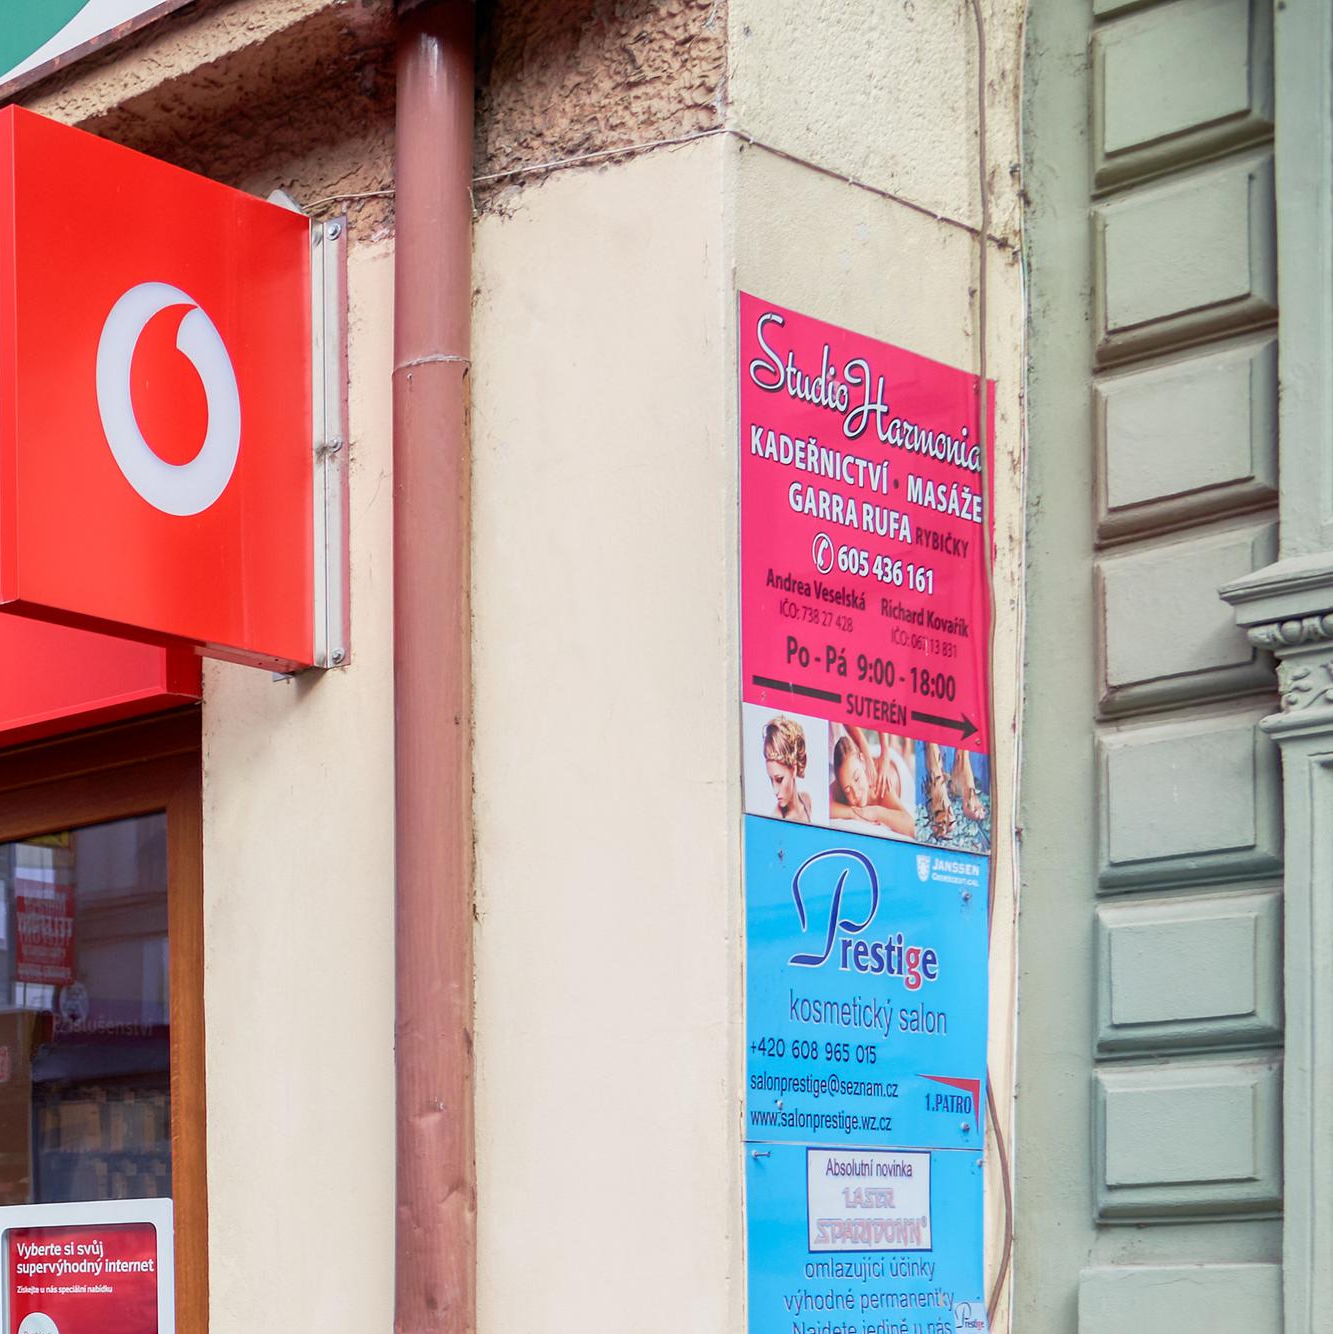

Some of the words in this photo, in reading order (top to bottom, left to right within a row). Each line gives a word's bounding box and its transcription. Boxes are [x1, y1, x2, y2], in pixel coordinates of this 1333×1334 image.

[749, 313, 850, 413] Studio
[842, 358, 982, 473] Harmonia
[750, 424, 890, 495] KADEŘNICTVÍ
[906, 474, 983, 524] MASÁŽE
[788, 481, 859, 529] GARRA
[861, 503, 913, 544] RUFA
[914, 526, 969, 560] RYBIČKY
[837, 544, 870, 578] 605
[872, 554, 904, 587] 436
[907, 564, 934, 595] 161
[766, 568, 812, 597] Andrea
[813, 577, 866, 612] Veselská
[779, 599, 801, 621] IČO:
[801, 605, 821, 626] 738
[821, 610, 835, 628] 27
[835, 613, 854, 633] 428
[881, 598, 925, 627] Richard
[926, 611, 969, 639] Kovařík
[786, 635, 810, 668] Po
[826, 645, 848, 677] Pá
[856, 654, 896, 688] 9:00
[910, 666, 957, 702] 18:00
[845, 692, 908, 726] SUTERÉN
[932, 858, 980, 877] JANSSEN
[787, 848, 939, 991] Prestige
[789, 988, 894, 1039] kosmetický
[899, 1001, 948, 1035] salon
[750, 1037, 786, 1058] +420
[791, 1039, 819, 1060] 608
[825, 1041, 851, 1063] 965
[855, 1044, 878, 1065] 015
[750, 1071, 899, 1099] salonprestige@seznam.cz
[924, 1092, 973, 1115] 1.PATRO
[750, 1108, 892, 1135] www.salonprestige.wz.cz
[825, 1158, 874, 1179] Absolutní
[876, 1159, 913, 1178] novinka
[842, 1186, 896, 1210] LASER
[16, 1242, 61, 1260] Vyberte
[63, 1242, 75, 1256] si
[78, 1239, 104, 1259] svůj
[16, 1258, 103, 1277] supervýhodný
[105, 1258, 154, 1273] internet
[804, 1257, 885, 1284] omlazující
[890, 1257, 936, 1283] účinky
[45, 1285, 58, 1294] nás
[58, 1284, 86, 1295] speciální
[87, 1284, 113, 1294] nabídku
[784, 1288, 856, 1317] výhodné
